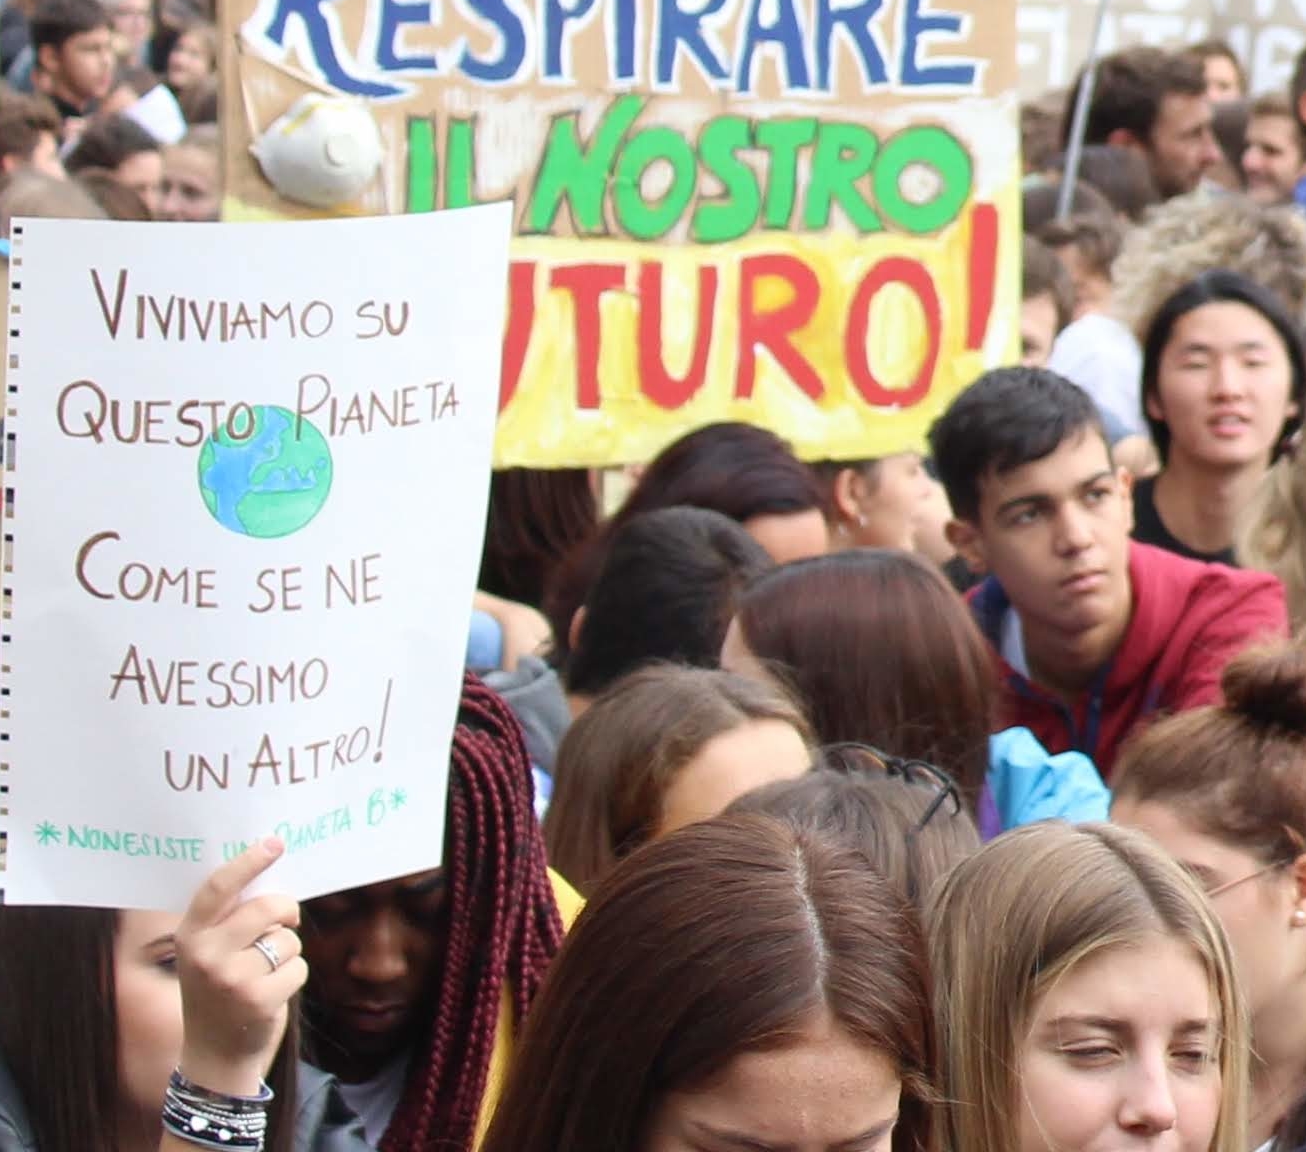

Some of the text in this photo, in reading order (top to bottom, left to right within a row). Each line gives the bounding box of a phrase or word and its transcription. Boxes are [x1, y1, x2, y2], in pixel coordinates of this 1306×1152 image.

[520, 93, 975, 243] NOSTRO
[89, 268, 409, 342] VIVIVIAMO SU
[56, 374, 461, 448] QUESTO PIANETA
[75, 531, 383, 614] COME SE NE
[110, 645, 329, 708] AVESSIMO
[164, 678, 393, 791] UN ALTRO!
